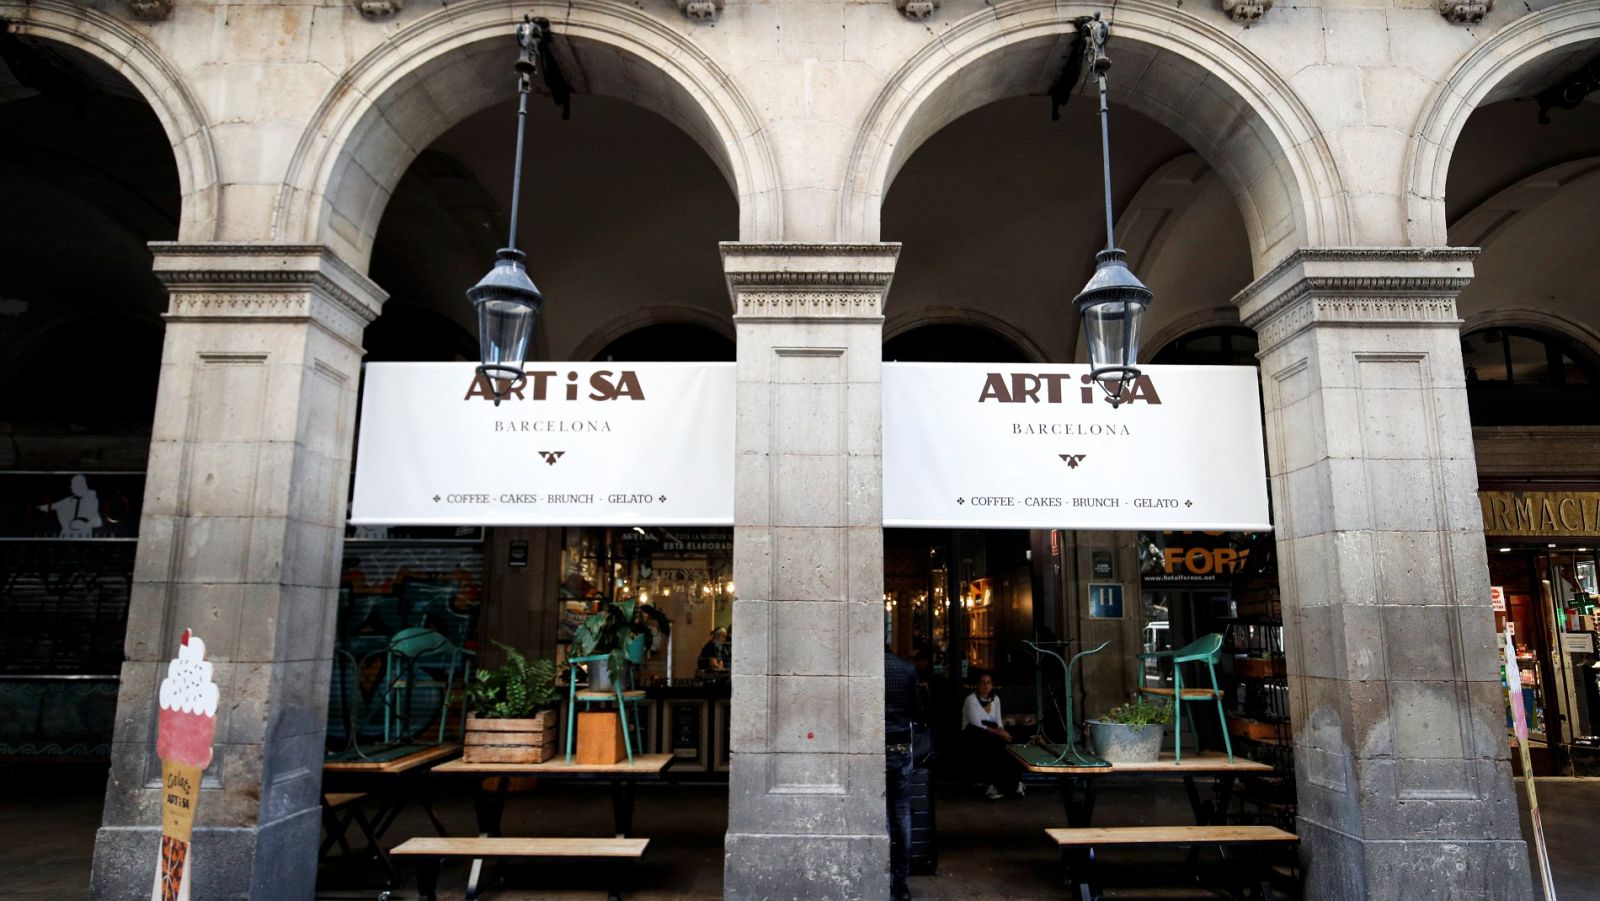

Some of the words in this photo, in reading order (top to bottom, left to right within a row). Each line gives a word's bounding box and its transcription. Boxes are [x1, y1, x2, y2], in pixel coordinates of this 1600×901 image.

[494, 420, 612, 433] BARCELONA
[1012, 423, 1131, 436] BARCELONA
[446, 493, 490, 504] COFFEE
[500, 494, 537, 504] CAKES
[547, 494, 594, 504] BRUNCH
[608, 494, 653, 504] GELATO
[970, 496, 1015, 507] COFFEE
[1024, 497, 1062, 507] CAKES
[1072, 497, 1120, 508] BRUNCH
[1133, 497, 1179, 508] GELATO
[1484, 498, 1600, 531] RMACI
